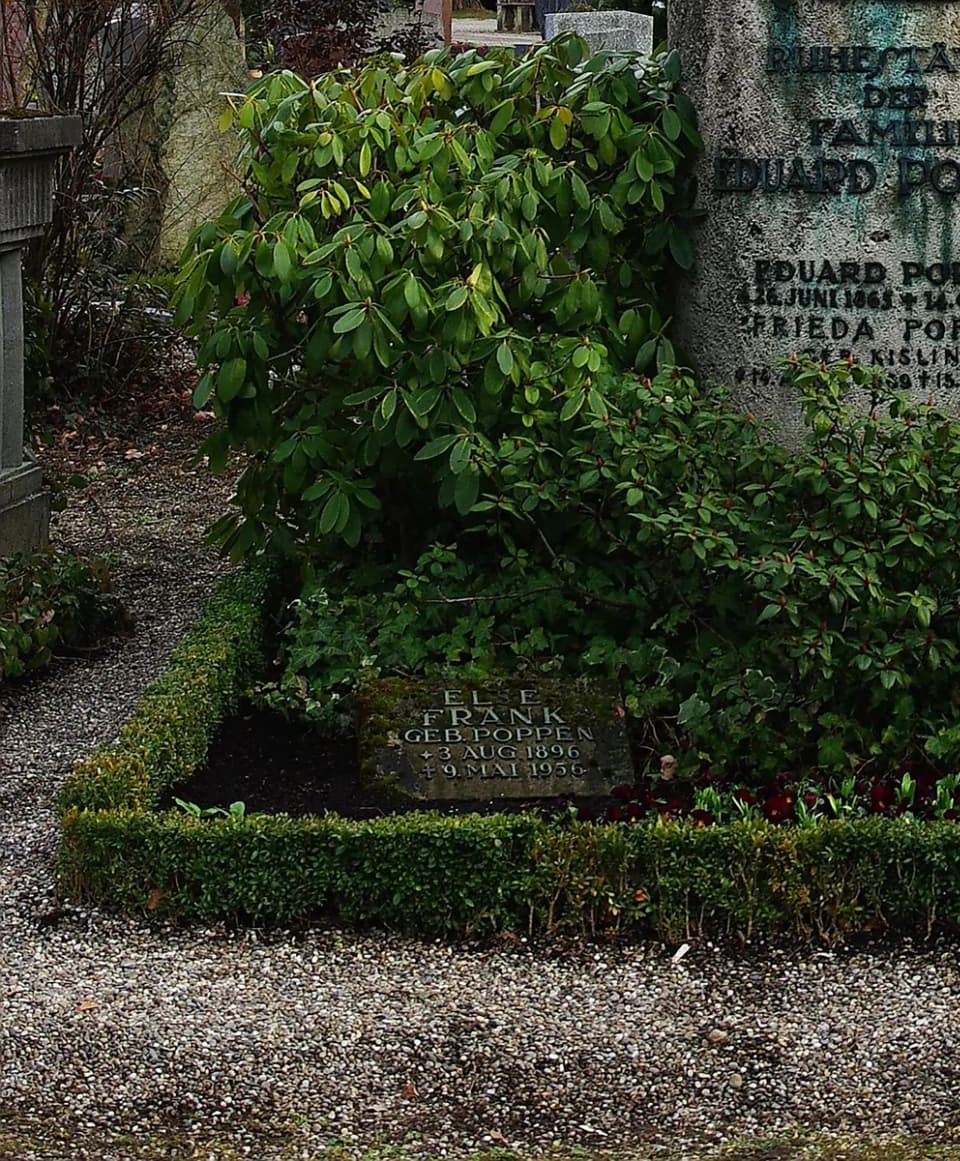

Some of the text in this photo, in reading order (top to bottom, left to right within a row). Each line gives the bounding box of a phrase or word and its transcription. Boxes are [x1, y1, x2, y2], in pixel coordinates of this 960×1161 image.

[863, 86, 929, 109] DER
[714, 157, 877, 193] EDUARD
[755, 260, 886, 283] EDUARD
[752, 313, 874, 341] FRIEDA
[444, 690, 541, 706] ELSE
[422, 707, 567, 727] FRANK
[404, 727, 595, 743] GEB. POPPEN
[462, 745, 518, 760] AUG
[527, 744, 580, 760] 1896
[467, 763, 519, 778] MAI
[531, 762, 584, 777] 1956
